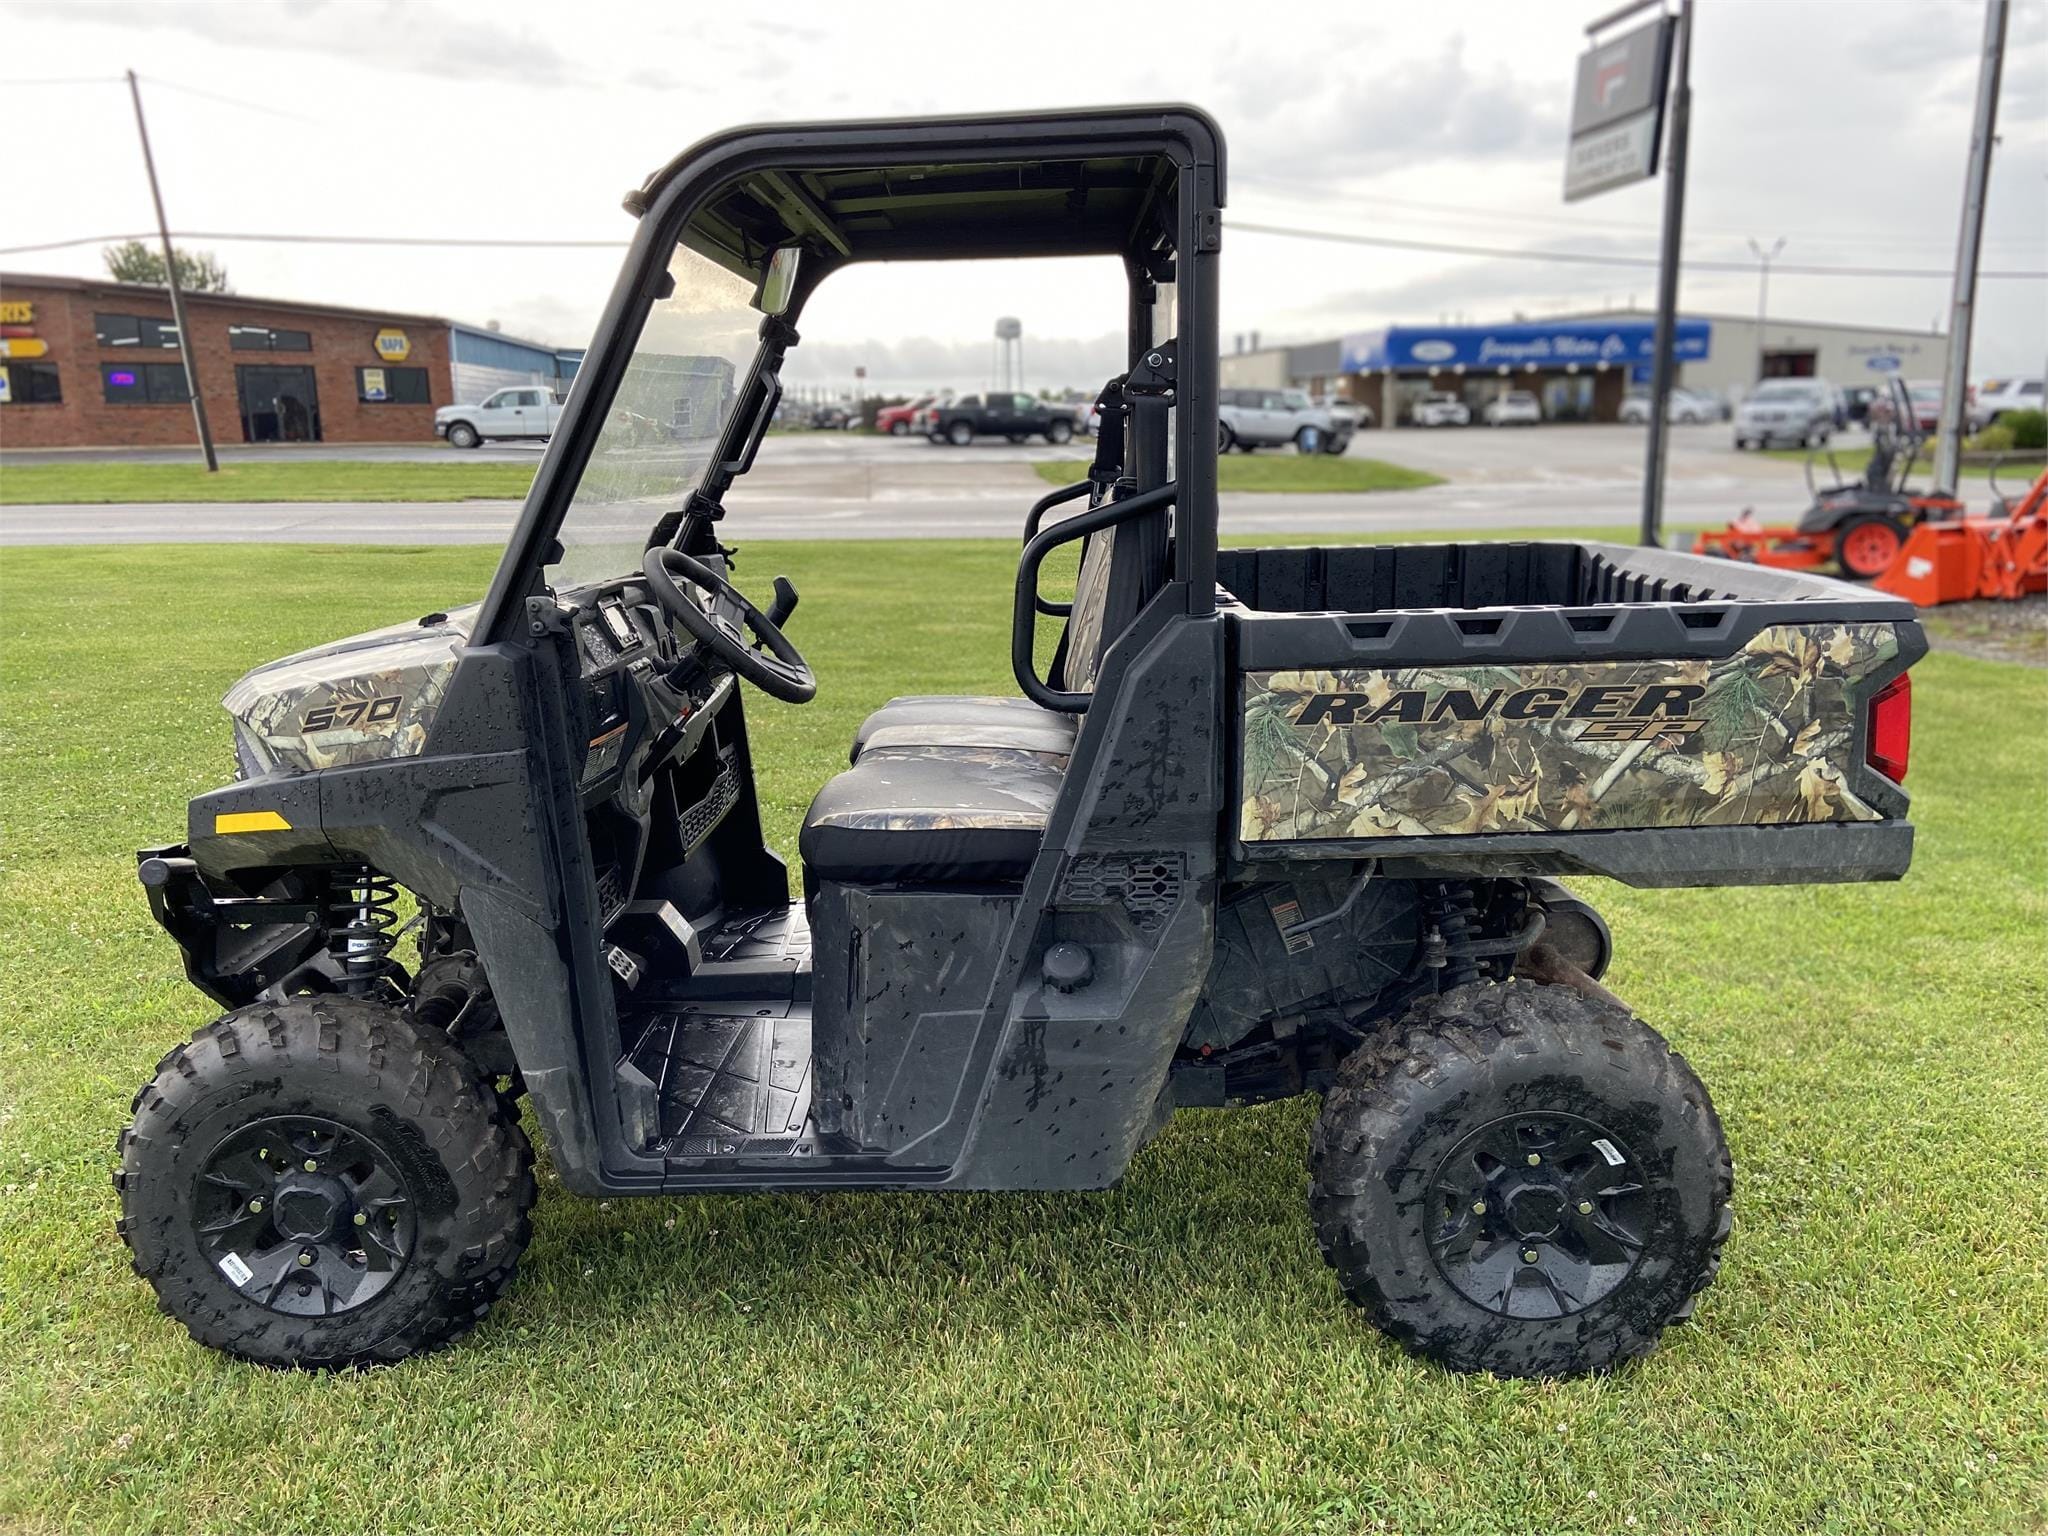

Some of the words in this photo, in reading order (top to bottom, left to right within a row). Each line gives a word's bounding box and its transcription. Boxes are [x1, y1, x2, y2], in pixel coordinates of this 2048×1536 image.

[301, 695, 403, 733] 570
[1294, 684, 1706, 726] RANGER
[1575, 719, 1709, 742] SP
